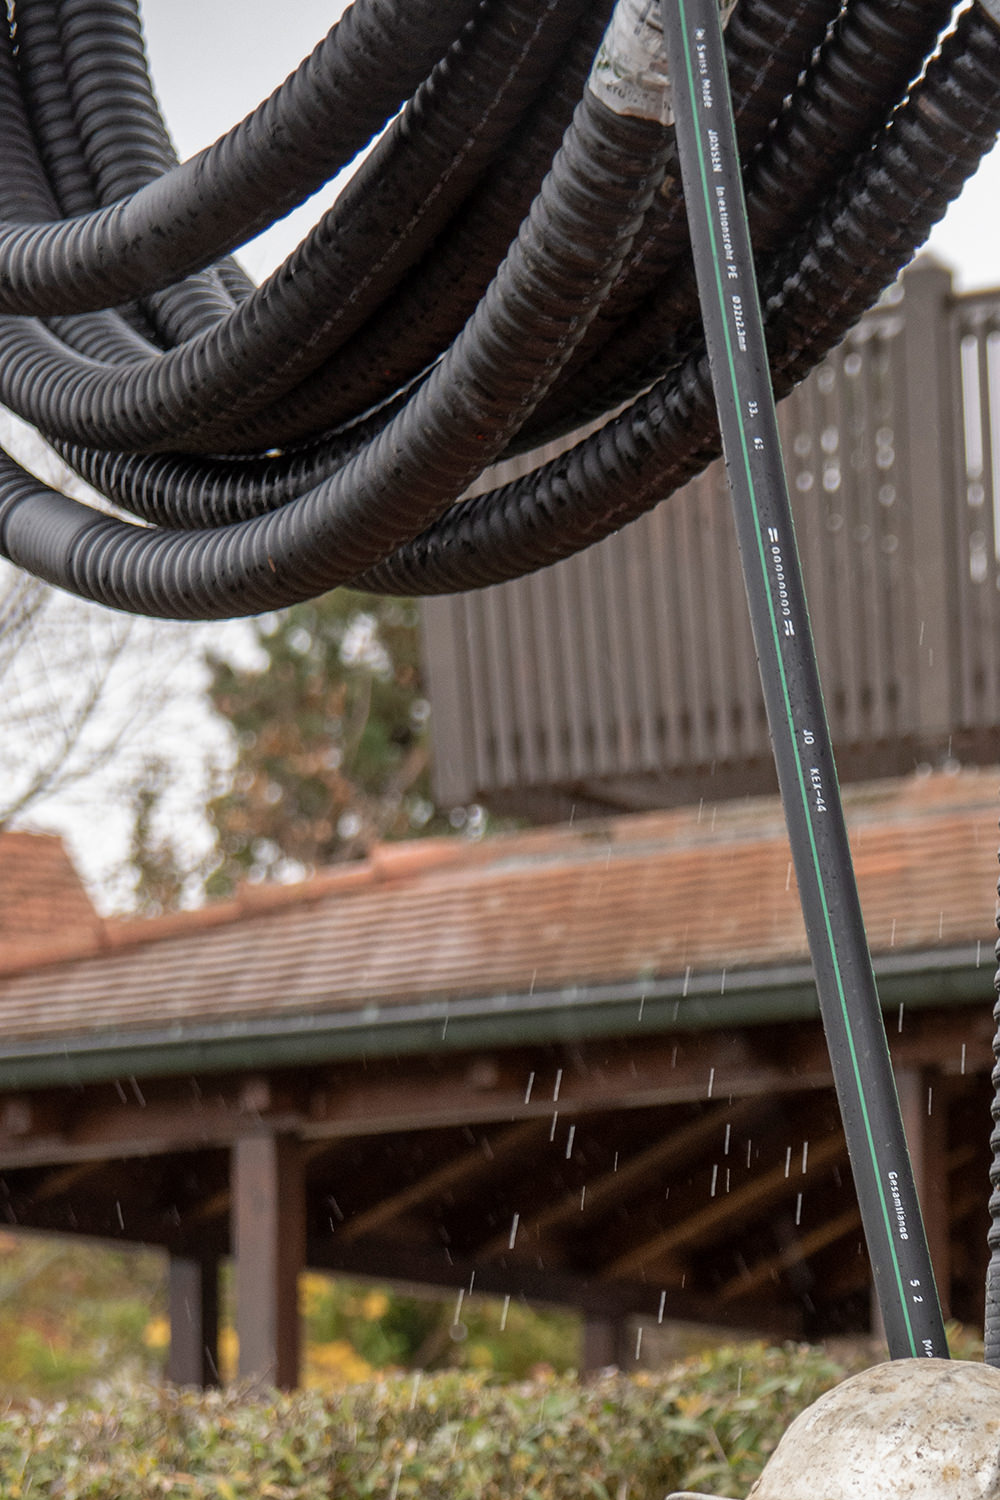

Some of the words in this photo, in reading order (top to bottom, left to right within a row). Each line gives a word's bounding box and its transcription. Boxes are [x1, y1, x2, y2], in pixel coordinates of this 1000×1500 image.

[696, 44, 709, 75] Swiss
[701, 78, 713, 109] Made
[707, 129, 723, 173] JANSEN
[727, 265, 738, 280] PE
